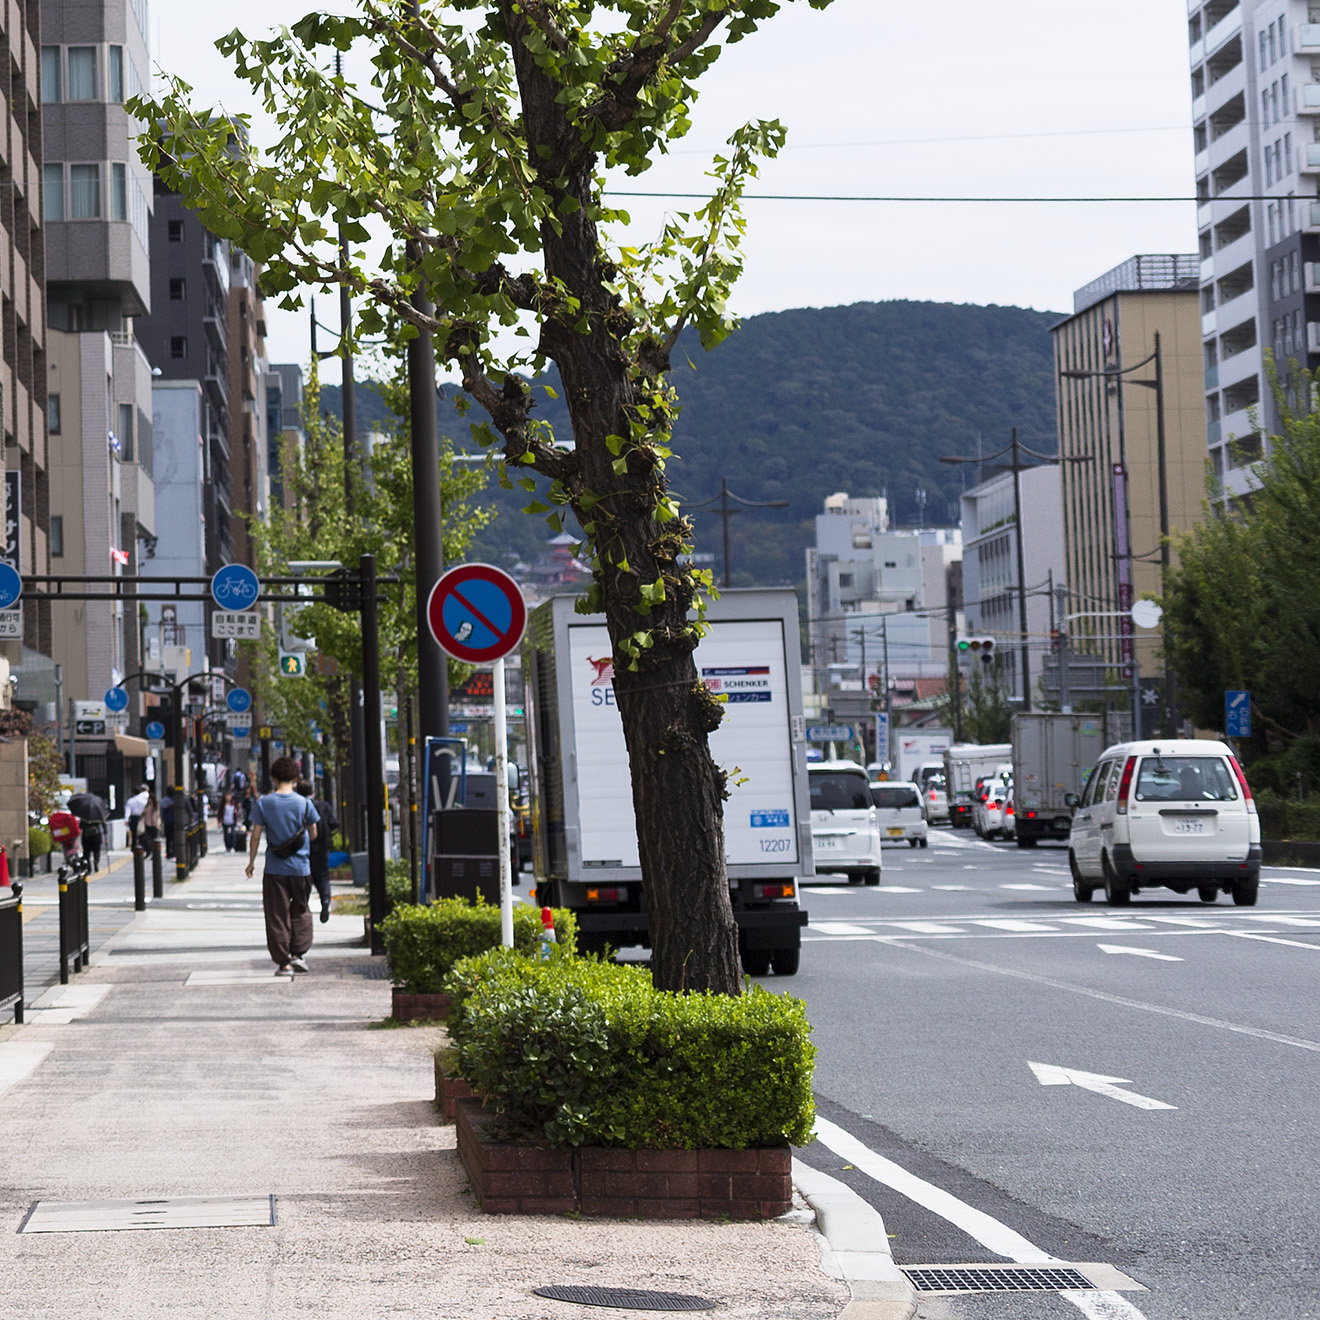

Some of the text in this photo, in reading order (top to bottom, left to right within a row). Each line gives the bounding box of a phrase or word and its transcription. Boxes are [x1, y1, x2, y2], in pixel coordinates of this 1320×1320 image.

[215, 614, 257, 625] 自転車道
[217, 625, 255, 636] ここまで
[724, 680, 769, 688] SCHENKER
[94, 722, 104, 735] P
[760, 840, 791, 852] 12207
